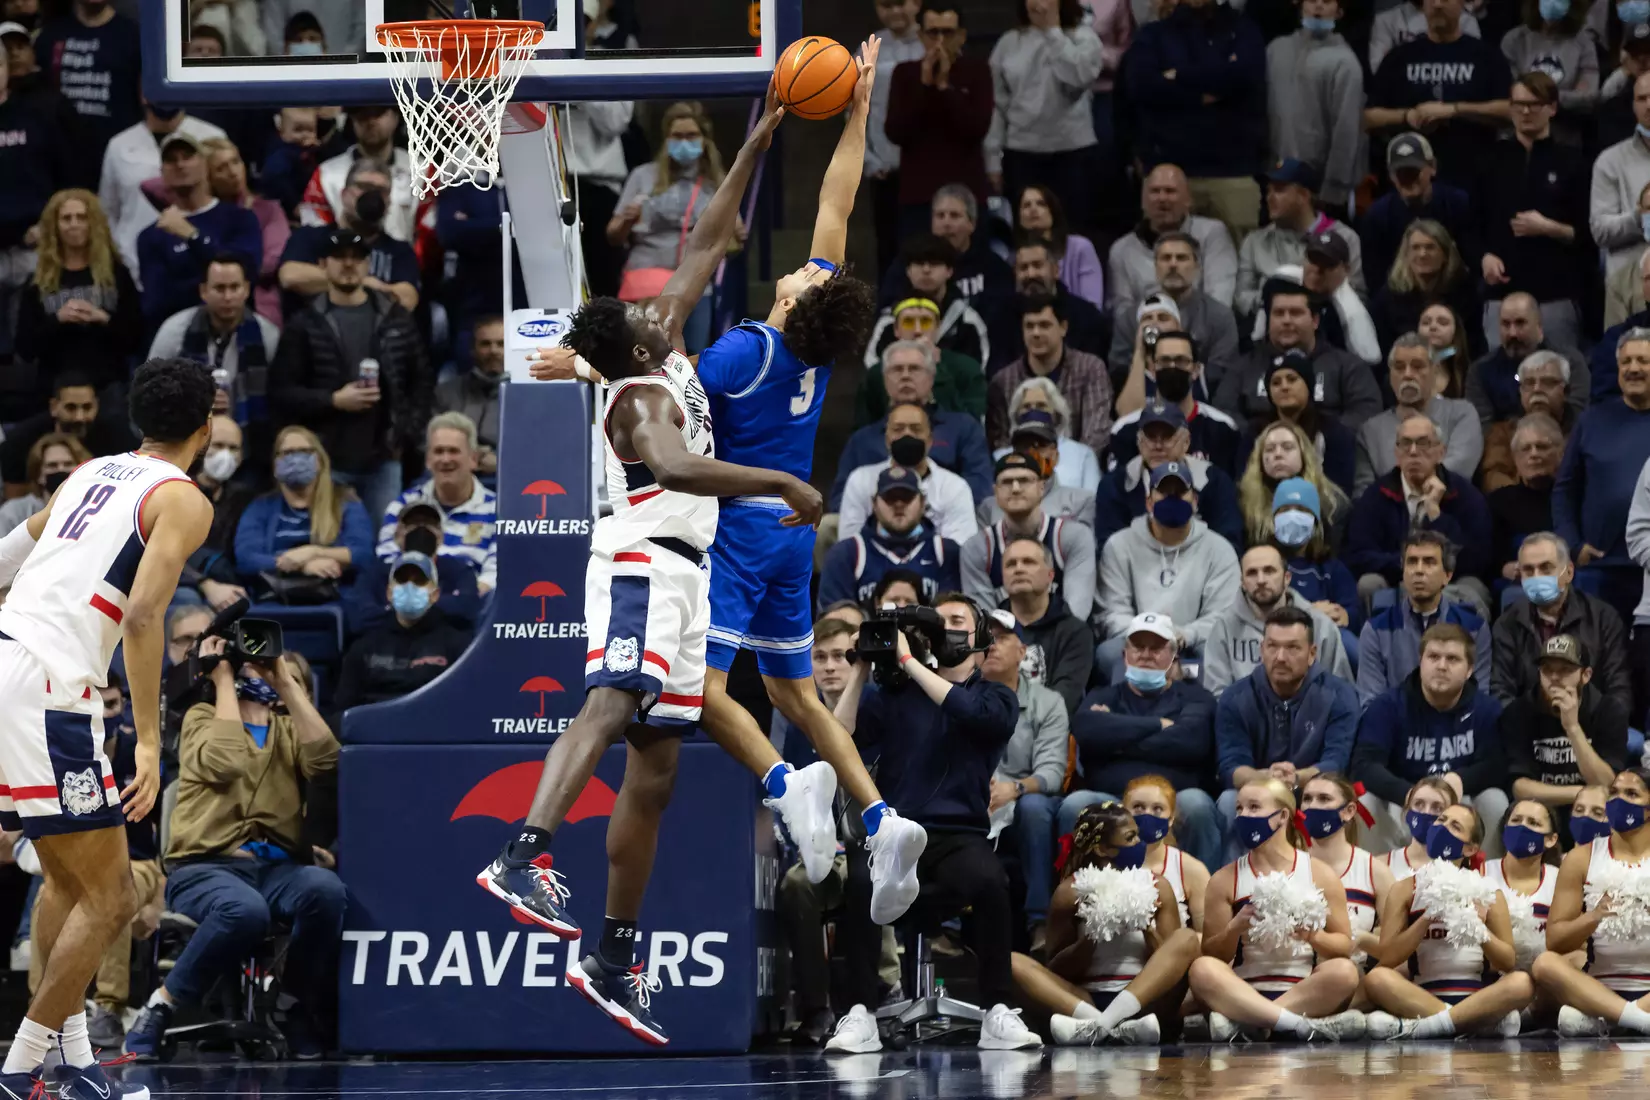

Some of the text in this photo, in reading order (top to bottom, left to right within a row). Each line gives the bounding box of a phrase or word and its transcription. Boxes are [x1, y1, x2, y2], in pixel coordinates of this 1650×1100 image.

[1406, 62, 1475, 81] UCONN
[789, 367, 819, 417] 3
[57, 484, 116, 541] 12
[495, 519, 589, 535] TRAVELERS
[1160, 568, 1176, 588] C
[493, 622, 589, 638] TRAVELERS
[491, 718, 575, 733] TRAVELE
[1406, 736, 1436, 762] WE
[518, 832, 538, 843] 23
[614, 927, 634, 938] 23
[341, 930, 729, 987] TRAVELRS
